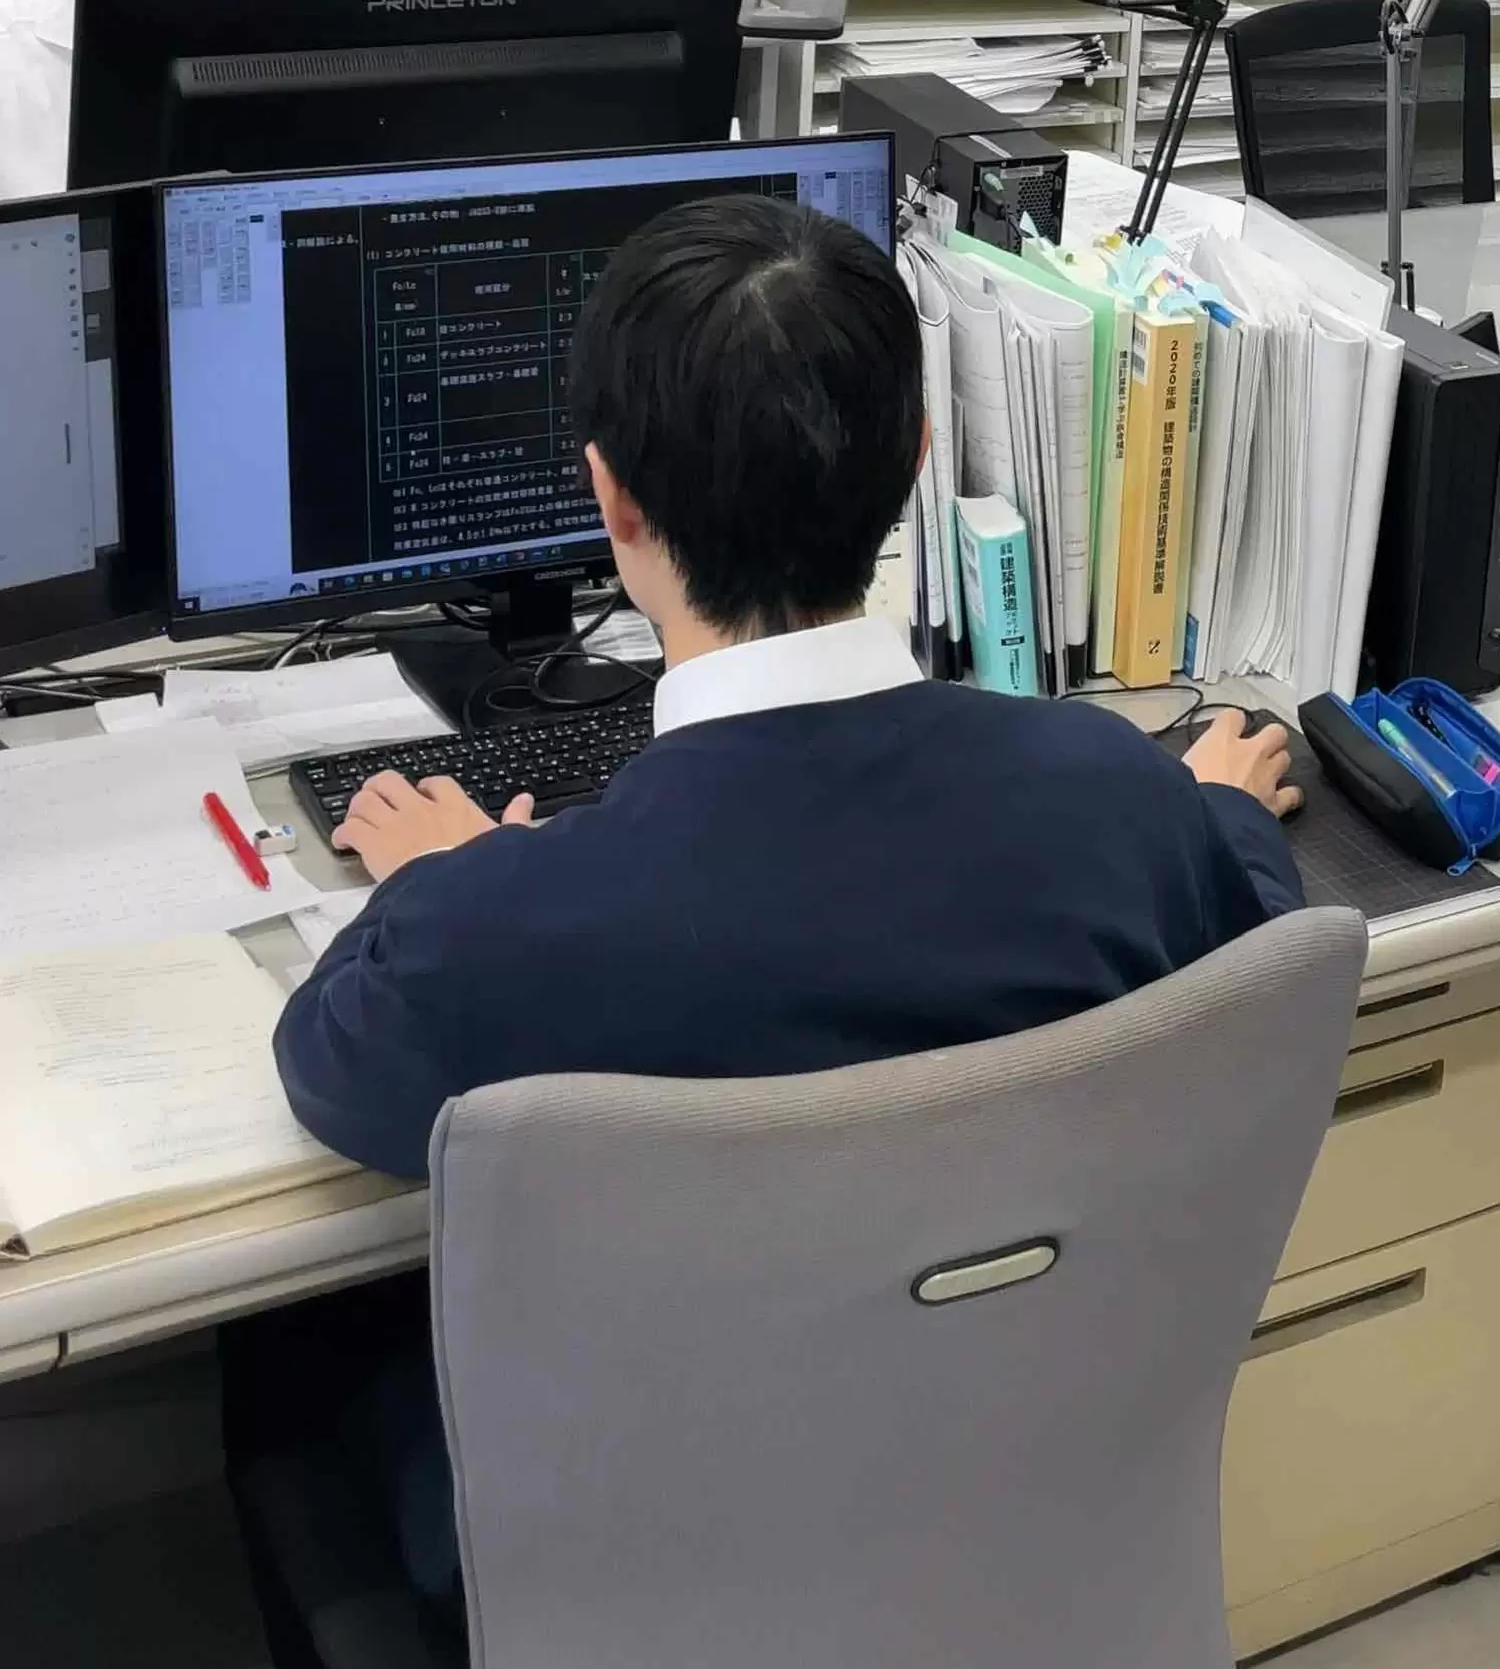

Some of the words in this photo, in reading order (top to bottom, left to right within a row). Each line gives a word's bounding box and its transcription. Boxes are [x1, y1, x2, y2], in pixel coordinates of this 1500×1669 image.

[1165, 340, 1178, 410] 2020年版
[1000, 556, 1018, 611] 建築構造
